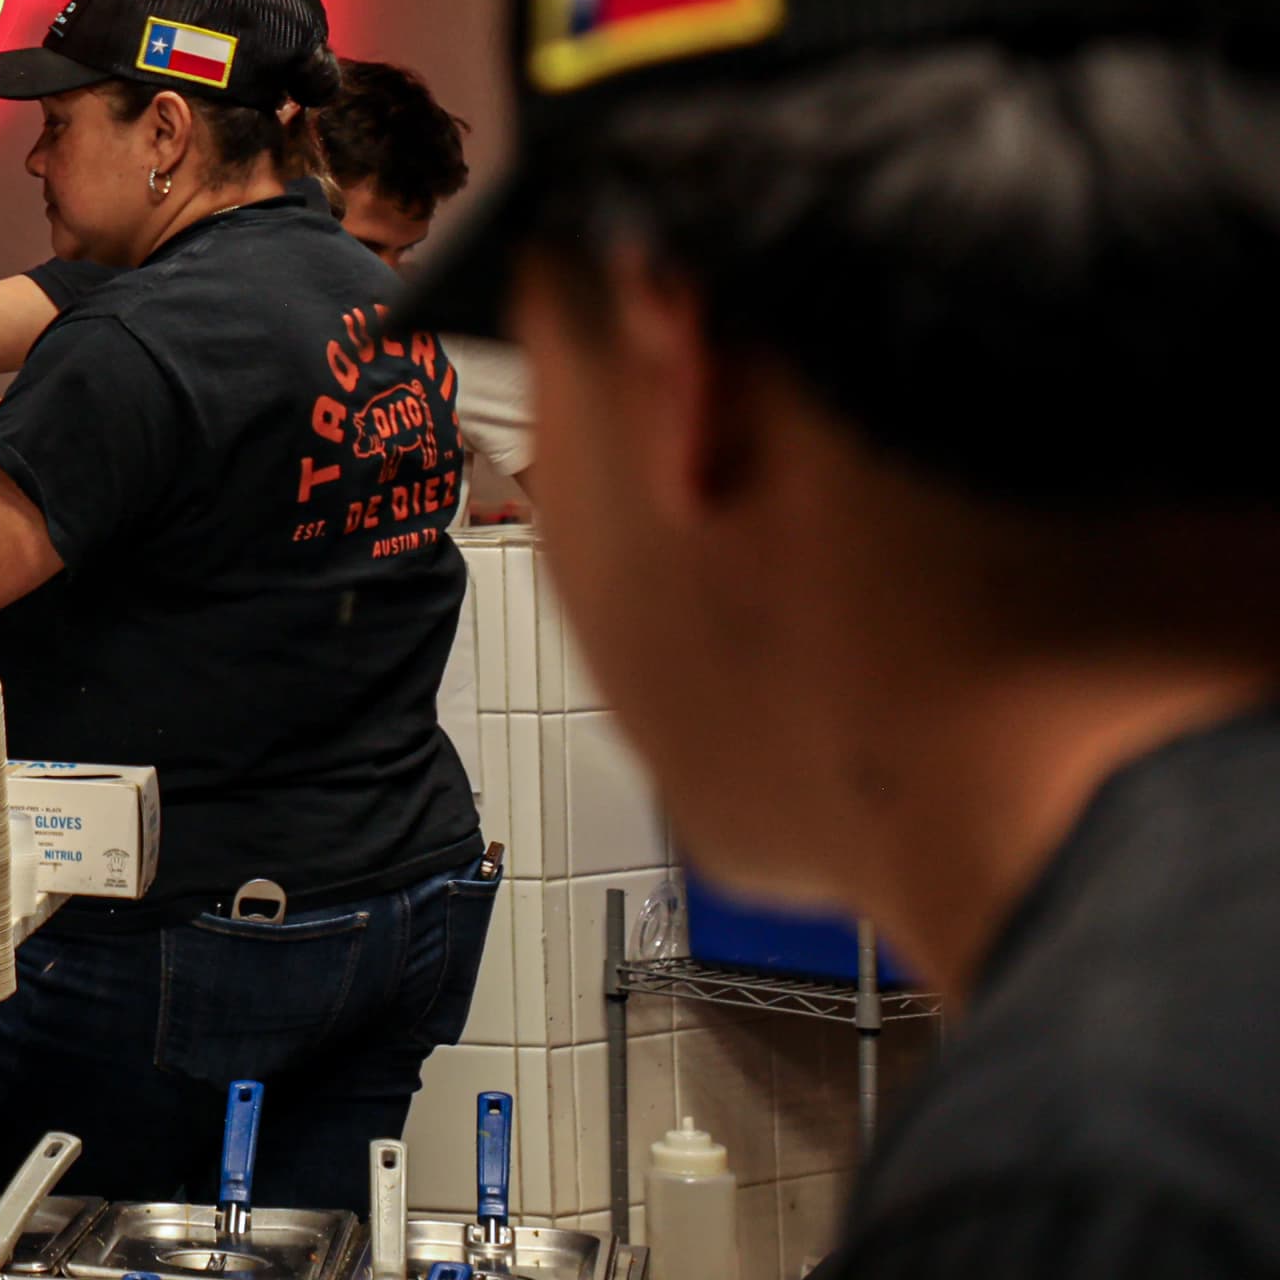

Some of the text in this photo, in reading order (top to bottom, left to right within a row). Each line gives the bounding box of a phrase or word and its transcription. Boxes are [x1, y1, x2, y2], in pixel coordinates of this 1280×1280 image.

[343, 470, 457, 535] DE DIEZ
[292, 520, 327, 542] EST.
[34, 815, 83, 831] GLOVES
[43, 849, 83, 862] NITRILO
